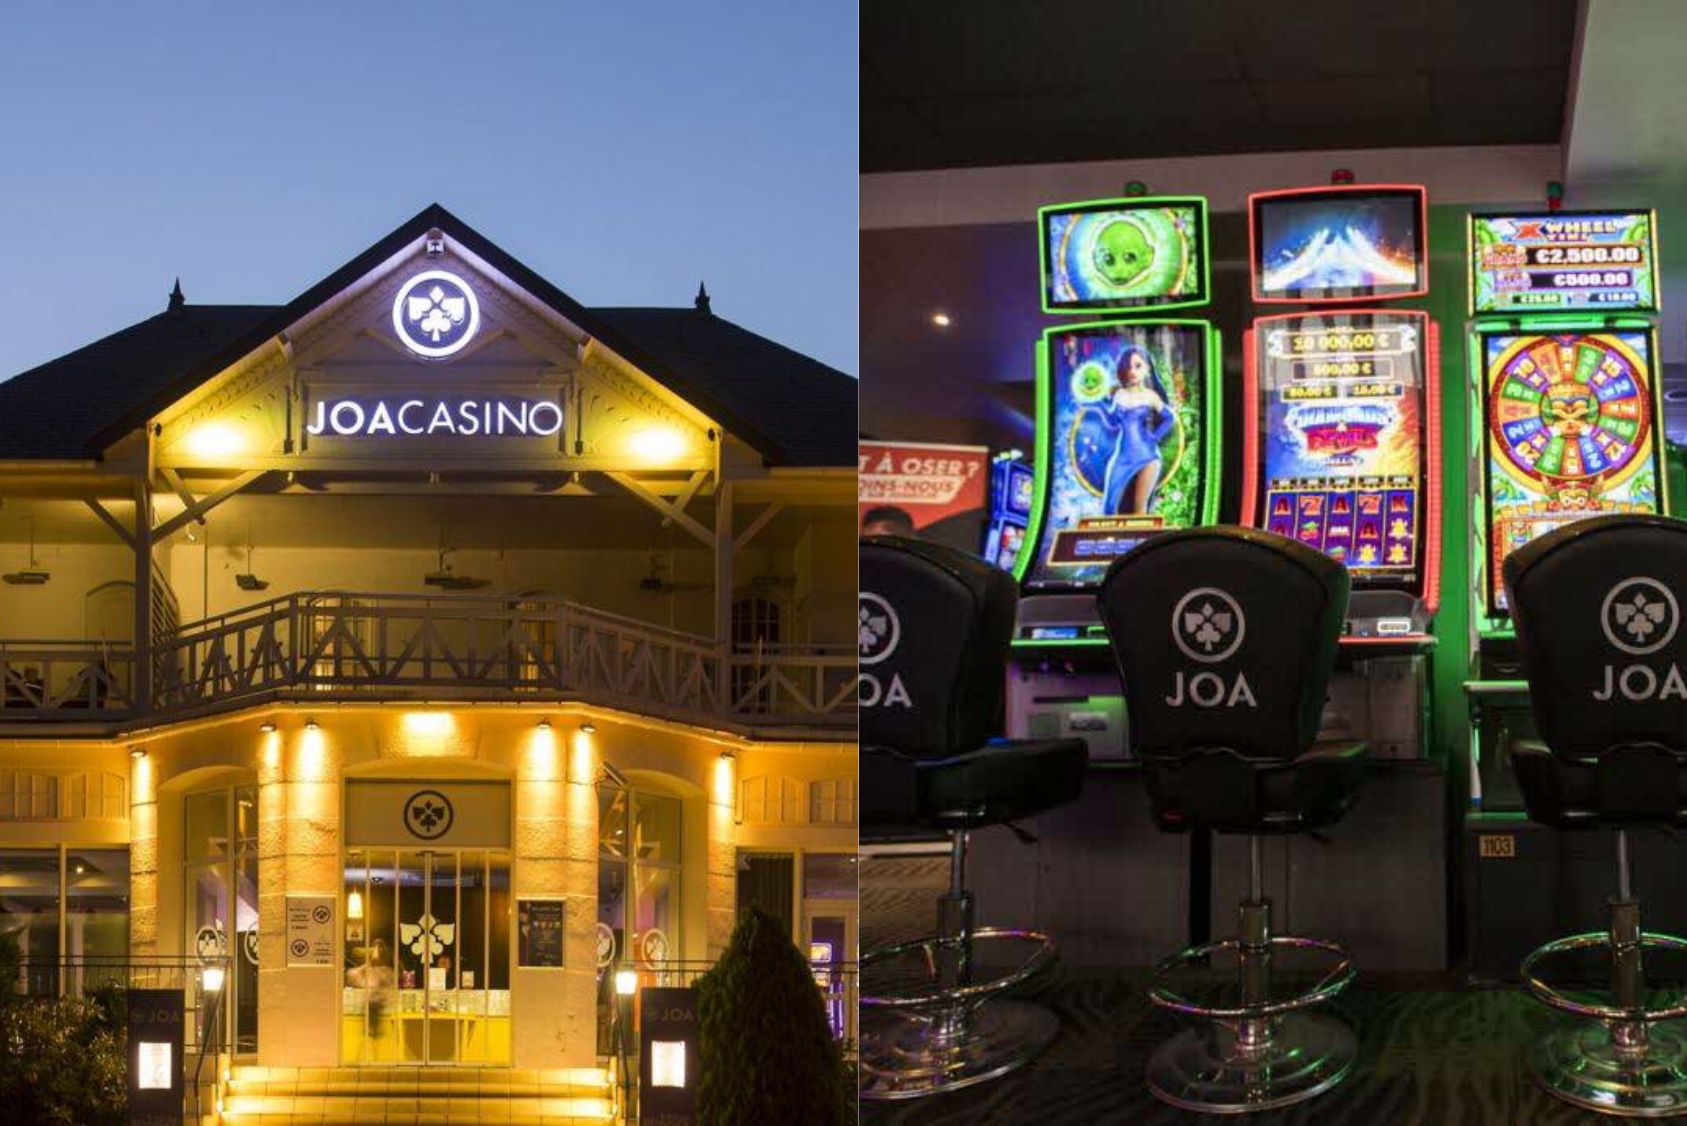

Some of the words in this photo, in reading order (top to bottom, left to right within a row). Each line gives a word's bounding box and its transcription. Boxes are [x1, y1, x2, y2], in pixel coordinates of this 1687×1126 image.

[1546, 221, 1617, 233] WHEEL
[1535, 247, 1639, 264] €2,500.00
[1553, 273, 1628, 286] €500.00
[306, 400, 563, 435] JOACASINO
[901, 457, 964, 476] OSER
[1165, 671, 1258, 707] JOA
[1592, 661, 1687, 702] JOA
[661, 1007, 695, 1025] JOA
